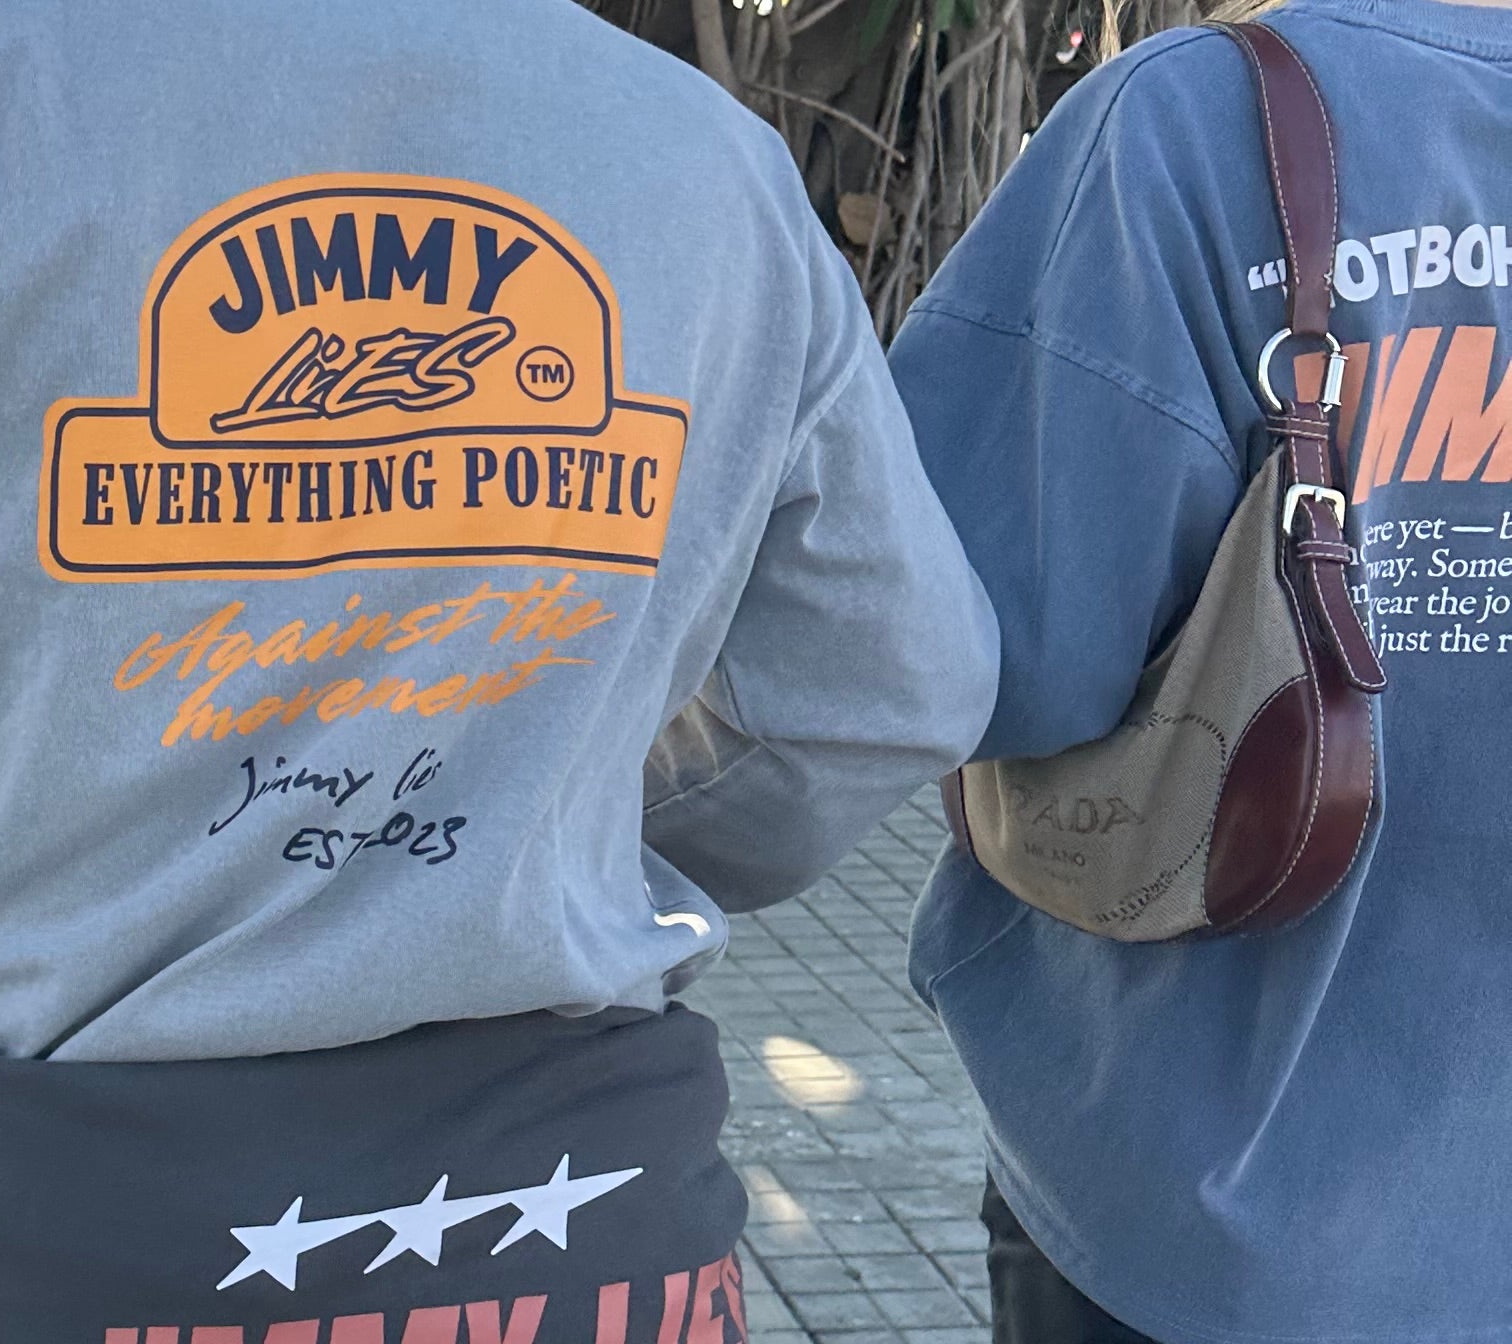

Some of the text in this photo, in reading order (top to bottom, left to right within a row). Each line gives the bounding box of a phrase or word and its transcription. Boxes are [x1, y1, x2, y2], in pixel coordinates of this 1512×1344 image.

[208, 212, 538, 334] JIMMY
[81, 446, 659, 527] EVERYTHING POETIC
[1396, 518, 1447, 550] yet
[113, 573, 617, 693] Against the
[1378, 624, 1432, 659] just
[1440, 623, 1490, 653] the
[1427, 586, 1477, 615] the
[160, 647, 595, 748] movement
